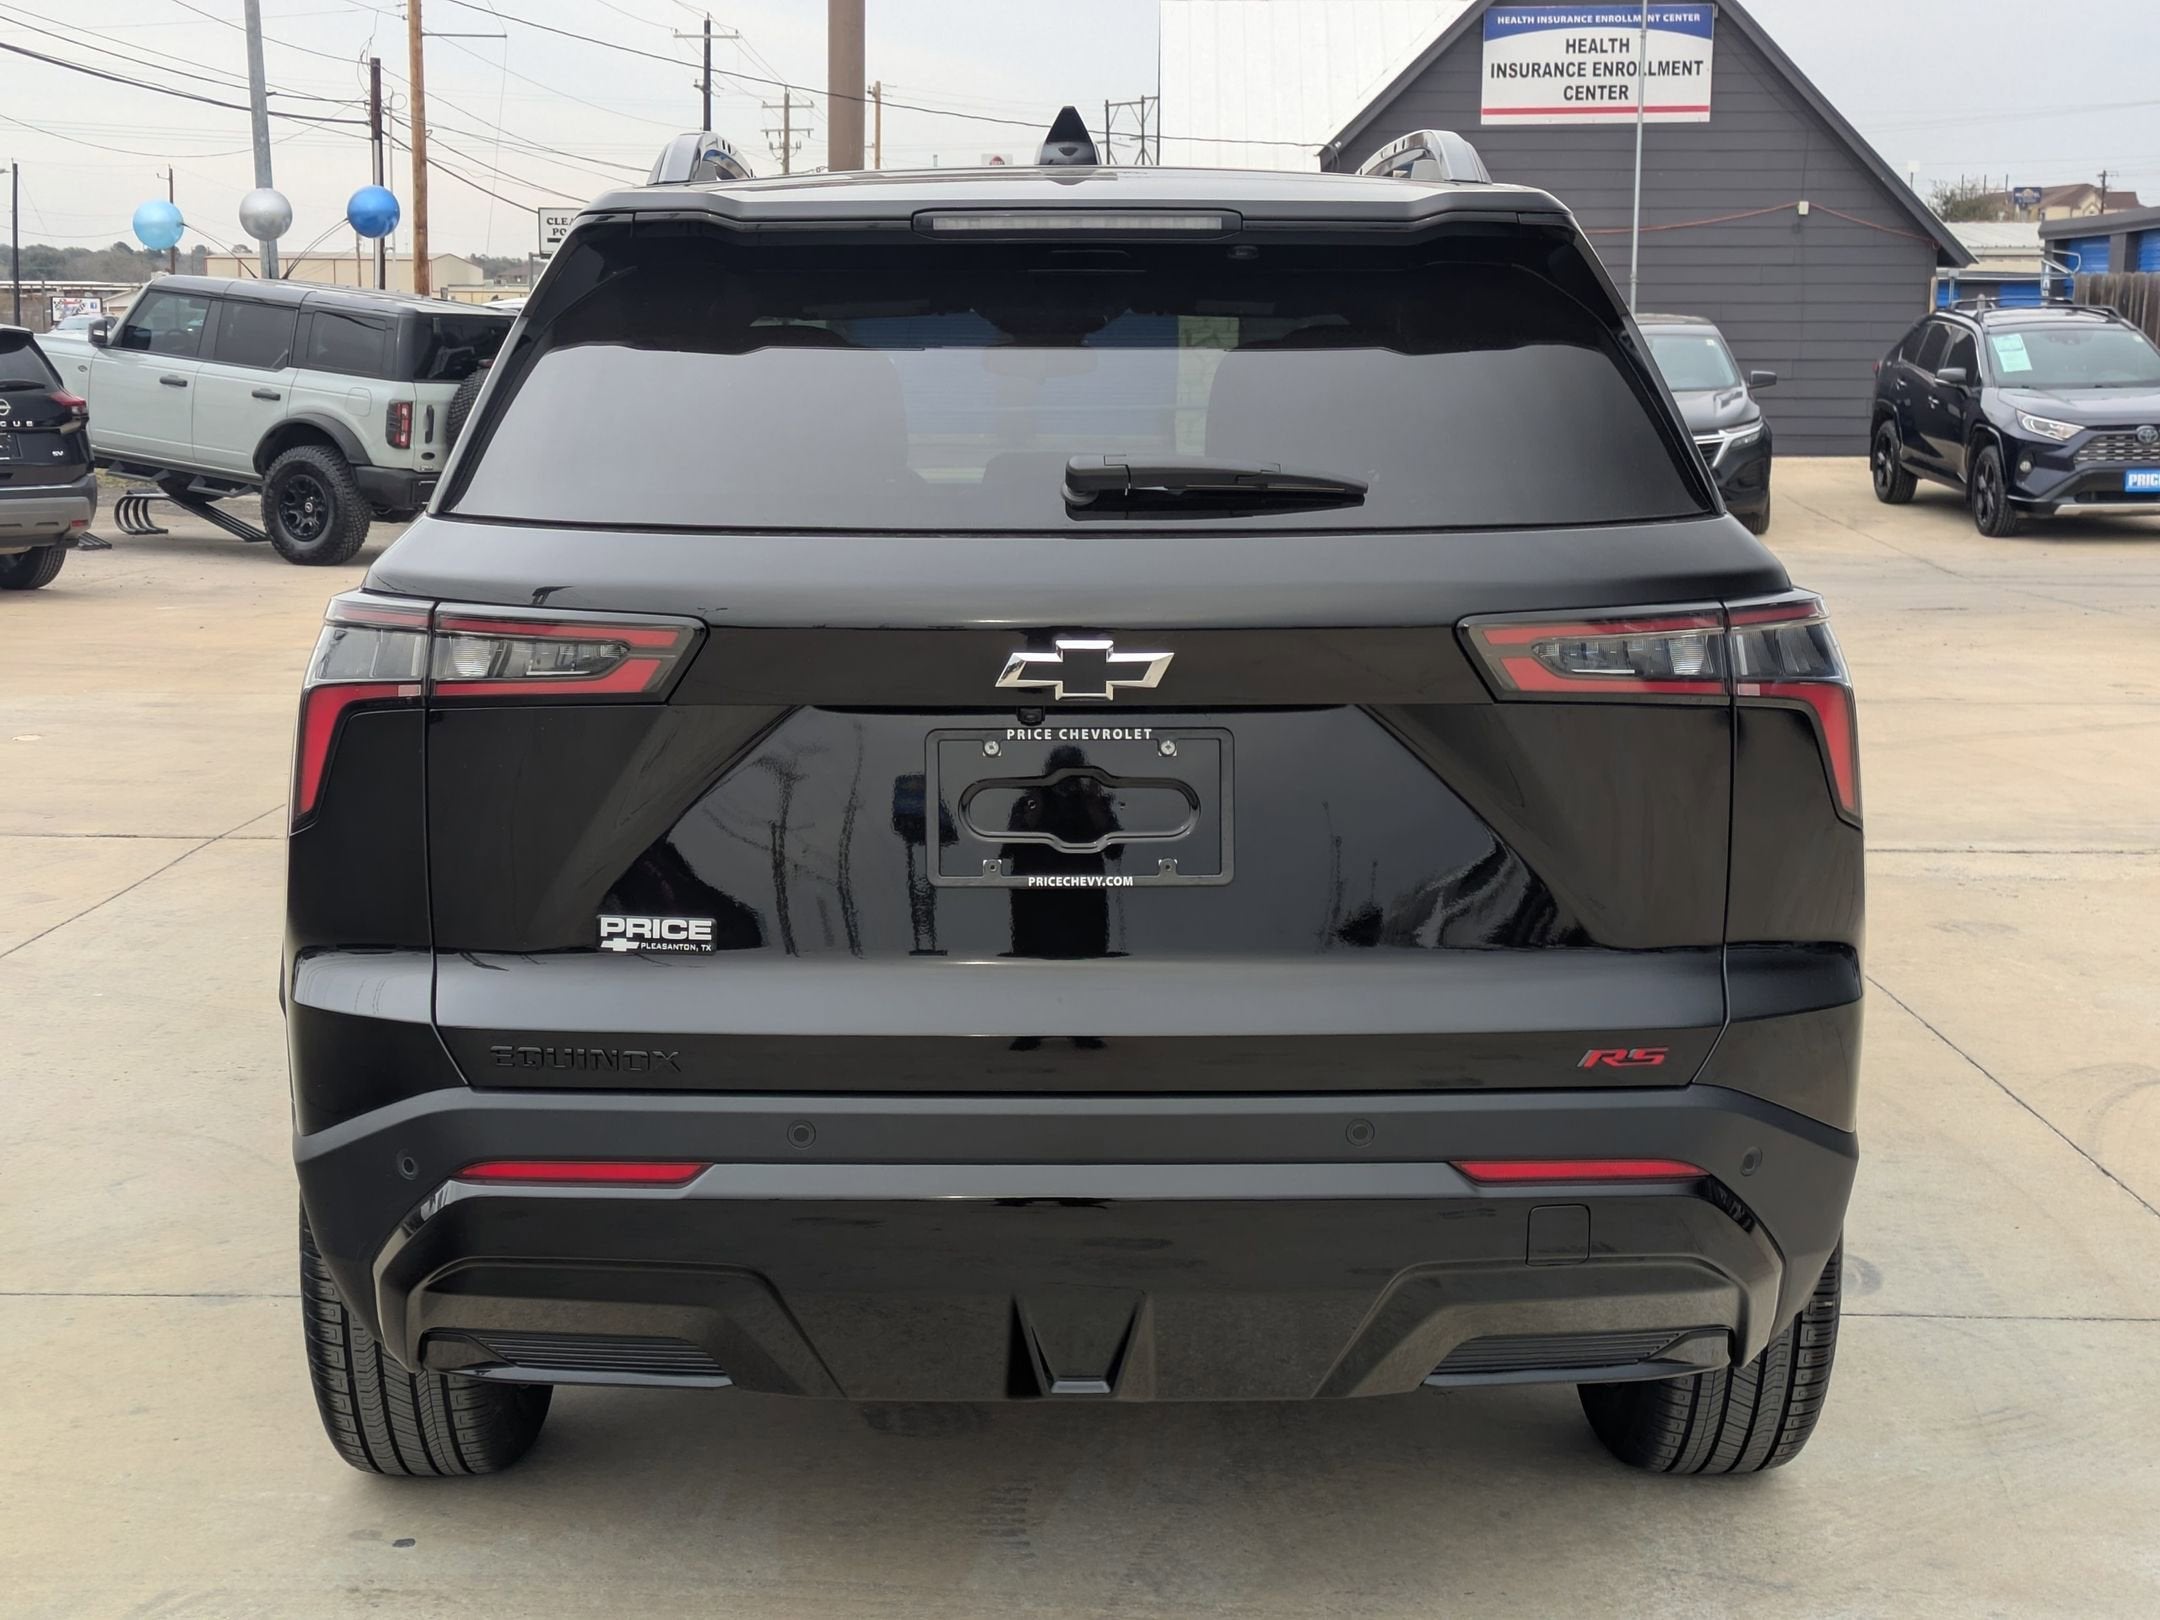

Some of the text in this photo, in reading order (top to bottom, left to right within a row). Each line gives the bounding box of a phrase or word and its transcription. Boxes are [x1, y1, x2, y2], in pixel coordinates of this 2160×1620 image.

[1497, 12, 1700, 25] HEALTH INSURANCE ENROLLMNT CENTER
[1565, 38, 1630, 54] HEALTH
[1491, 62, 1586, 79] INSURANCE
[1563, 85, 1629, 101] CENTER
[2128, 473, 2160, 487] PRIC
[1006, 728, 1153, 740] PRICE CHEVROLET
[1028, 876, 1133, 887] PRICECHEVY.COM
[600, 917, 712, 940] PRICE
[640, 942, 699, 952] PLEASANTON,
[490, 1045, 682, 1072] EQUINOX
[1577, 1047, 1669, 1068] RS
